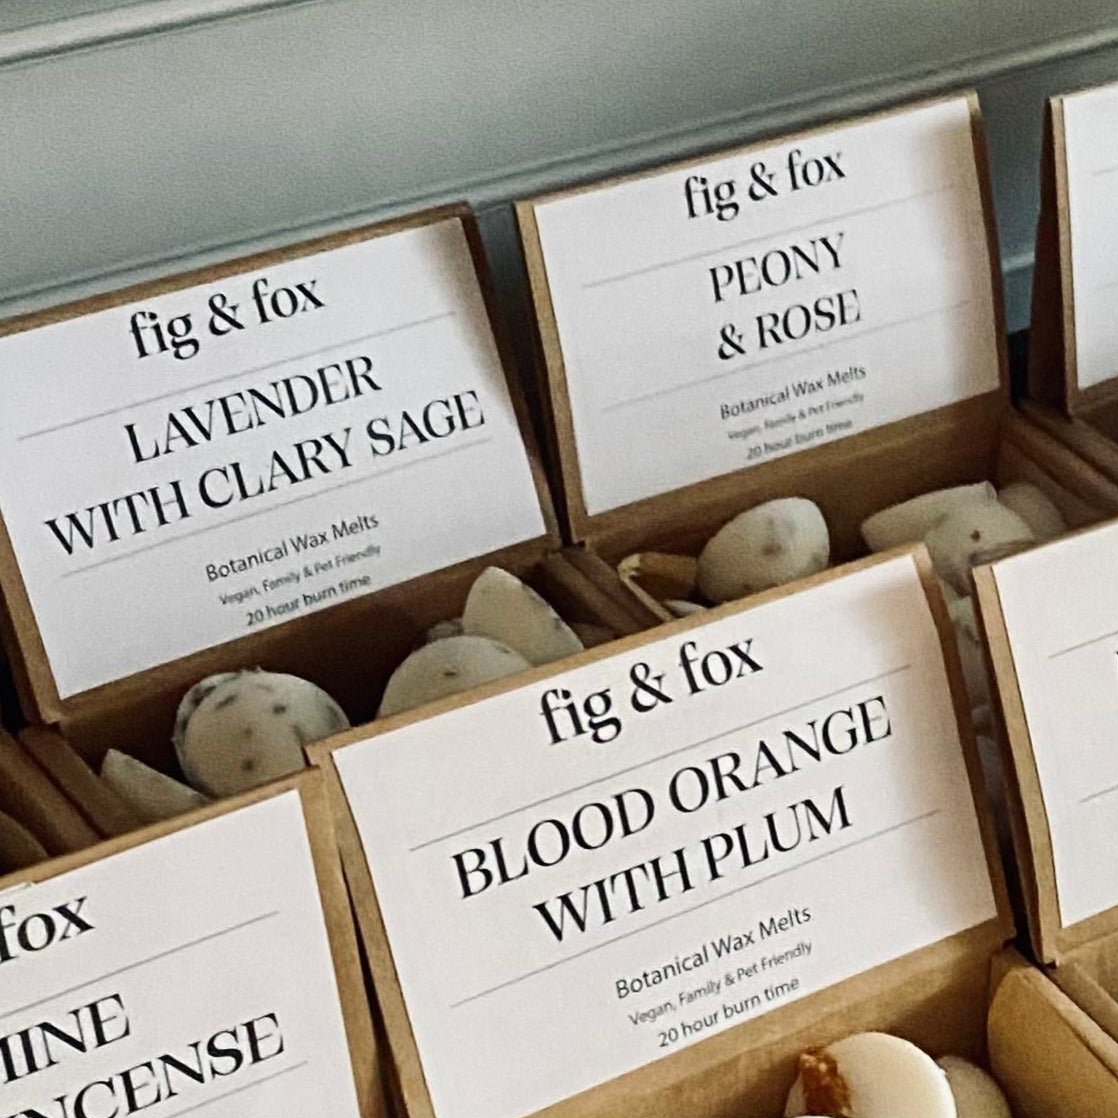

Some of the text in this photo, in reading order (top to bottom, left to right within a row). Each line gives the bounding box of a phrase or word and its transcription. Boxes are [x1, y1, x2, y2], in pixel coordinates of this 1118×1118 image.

[684, 149, 847, 221] fig & fox
[709, 232, 845, 303] PEONY
[129, 279, 325, 360] fig & fox
[718, 289, 862, 360] & ROSE
[125, 355, 382, 464] LAVENDER
[720, 366, 866, 420] Botanical Wax Melts
[45, 390, 485, 555] WITH CLARY SAGE
[206, 514, 379, 582] Botanical Wax Melts
[247, 575, 371, 626] 20 hour burn time
[539, 638, 764, 746] fig & fox
[451, 696, 892, 899] BLOOD ORANGE
[532, 786, 853, 943] WITH PLUM
[0, 896, 95, 964] fox
[615, 907, 811, 999] Botanical Wax Melts
[629, 941, 812, 1025] Vegan, Family & Pet Friendly
[659, 977, 800, 1047] 20 hour burn time
